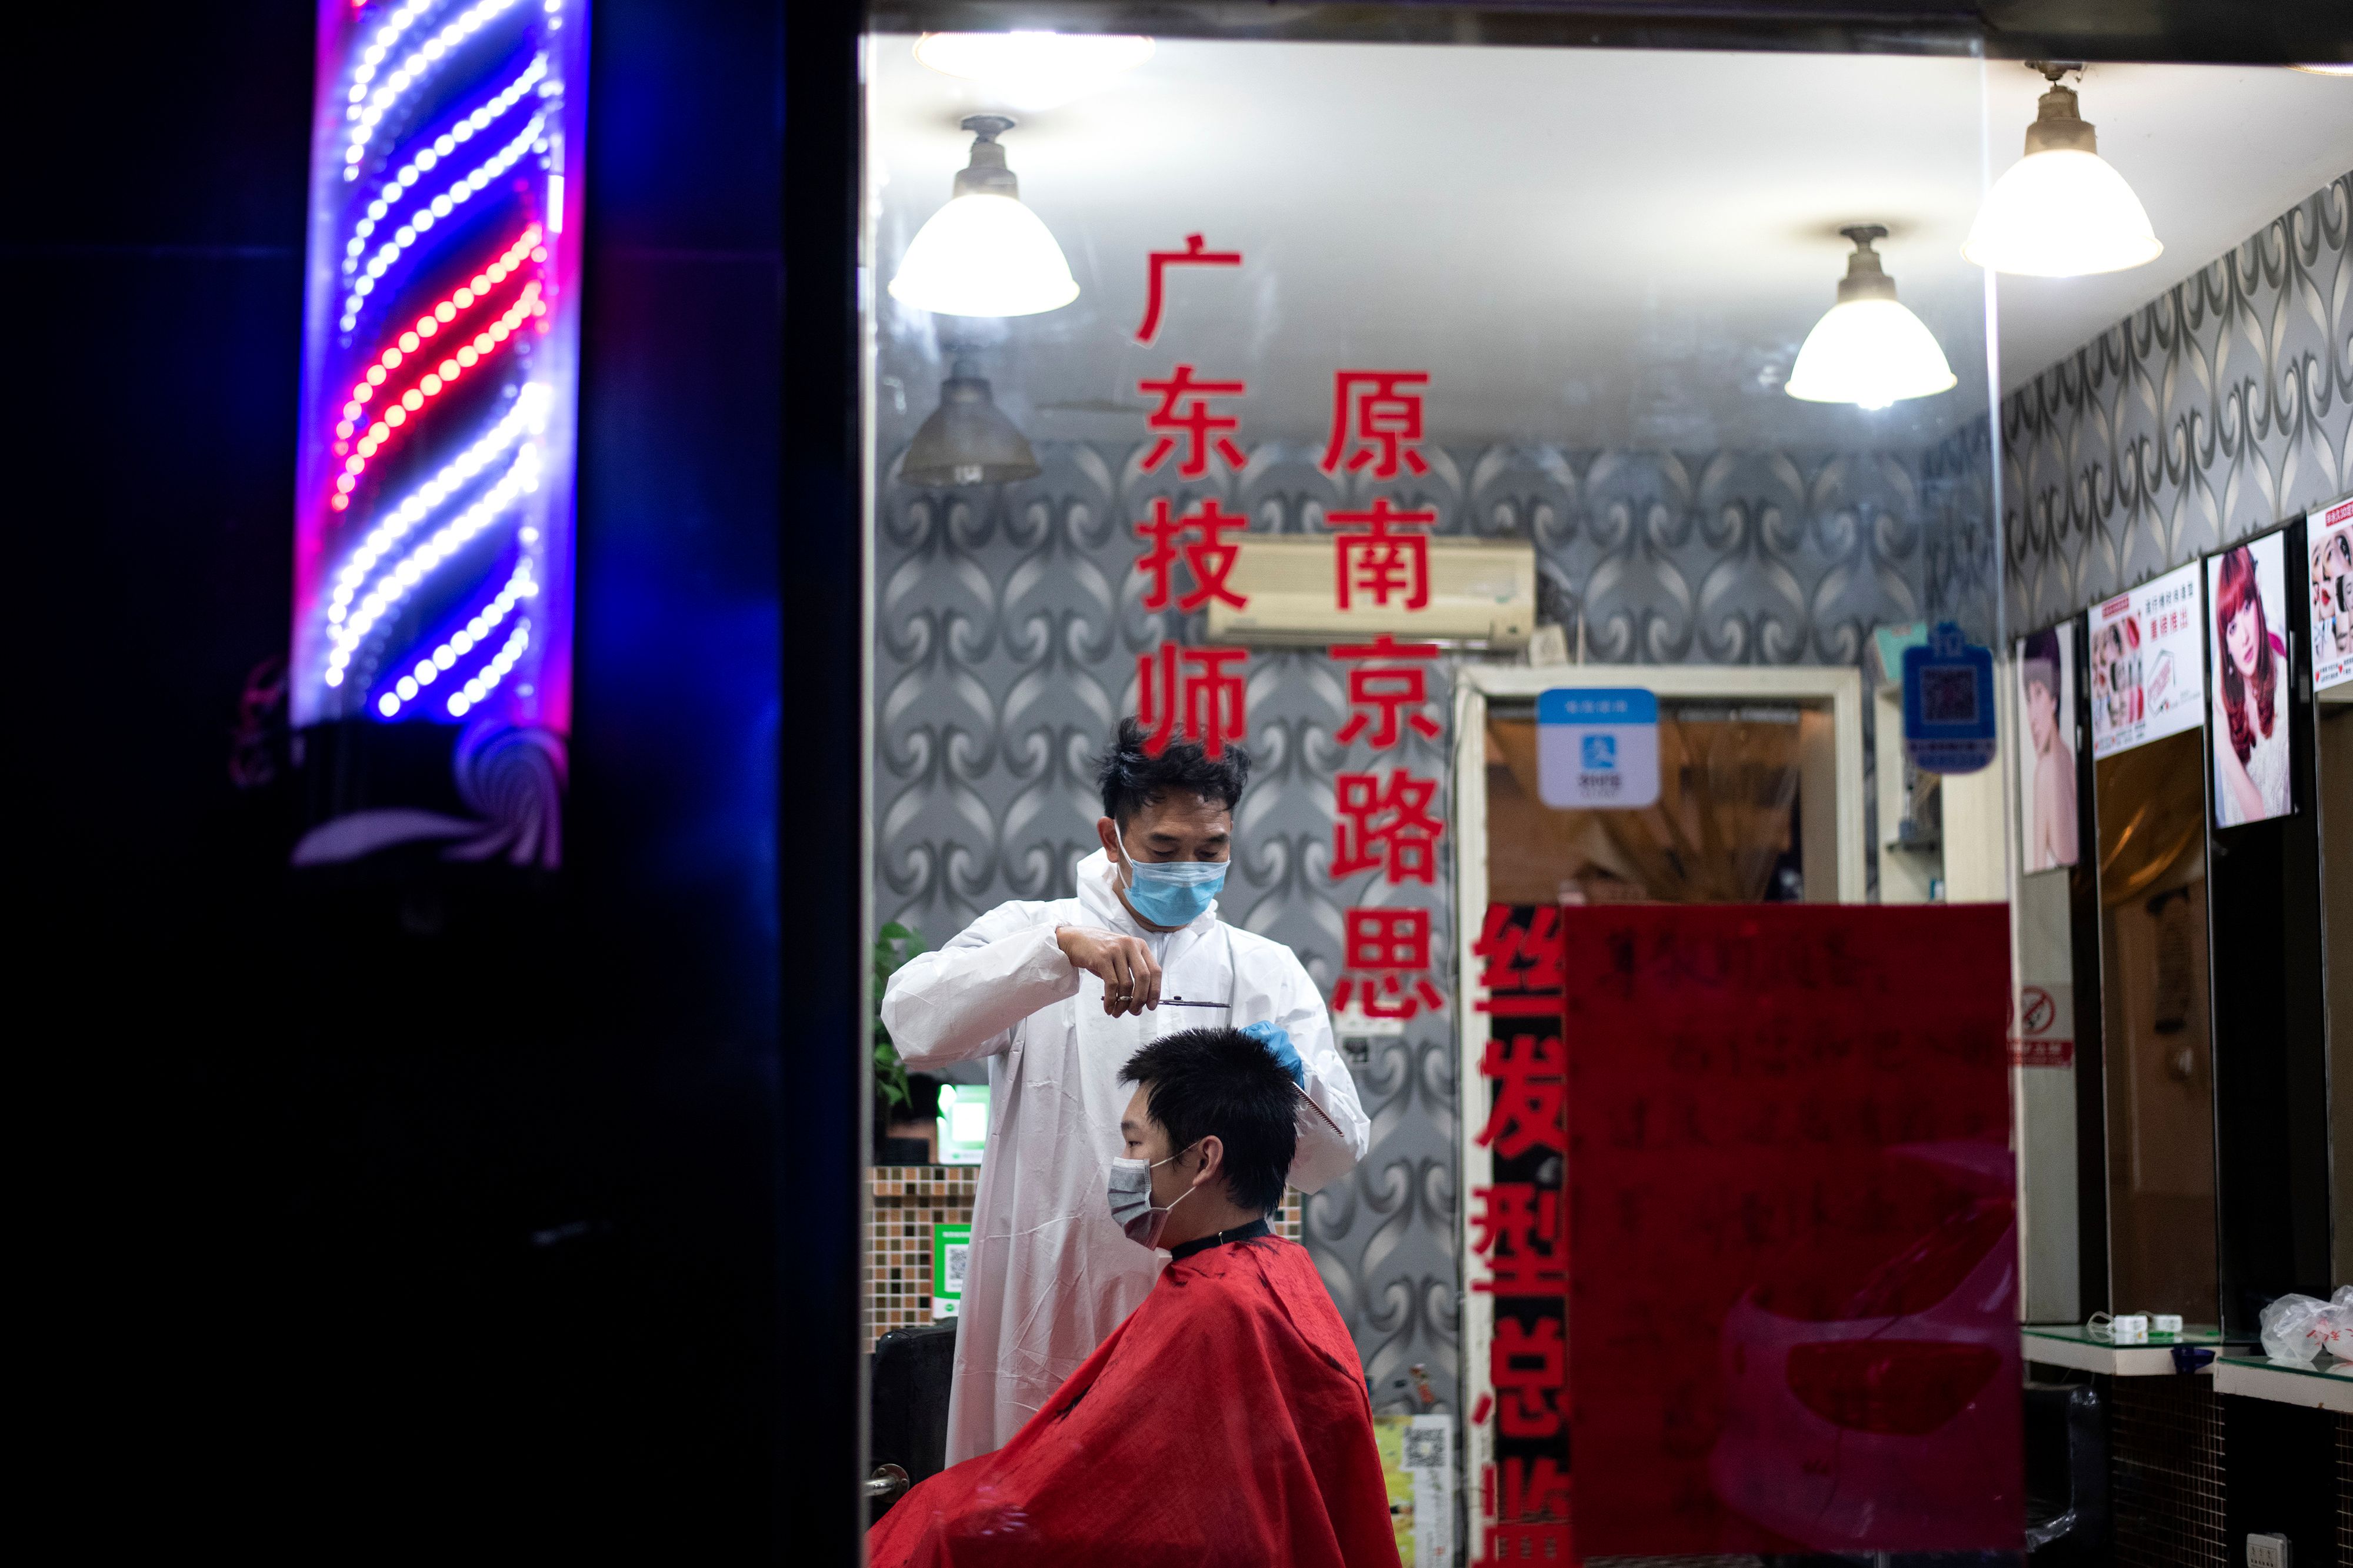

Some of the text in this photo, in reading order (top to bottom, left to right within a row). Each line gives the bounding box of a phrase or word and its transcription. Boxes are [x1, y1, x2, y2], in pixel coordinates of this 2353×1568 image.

[1135, 233, 1249, 760] 广东技师
[1320, 370, 1445, 1020] 原南京路思
[1471, 902, 1569, 1568] 丝发型总监
